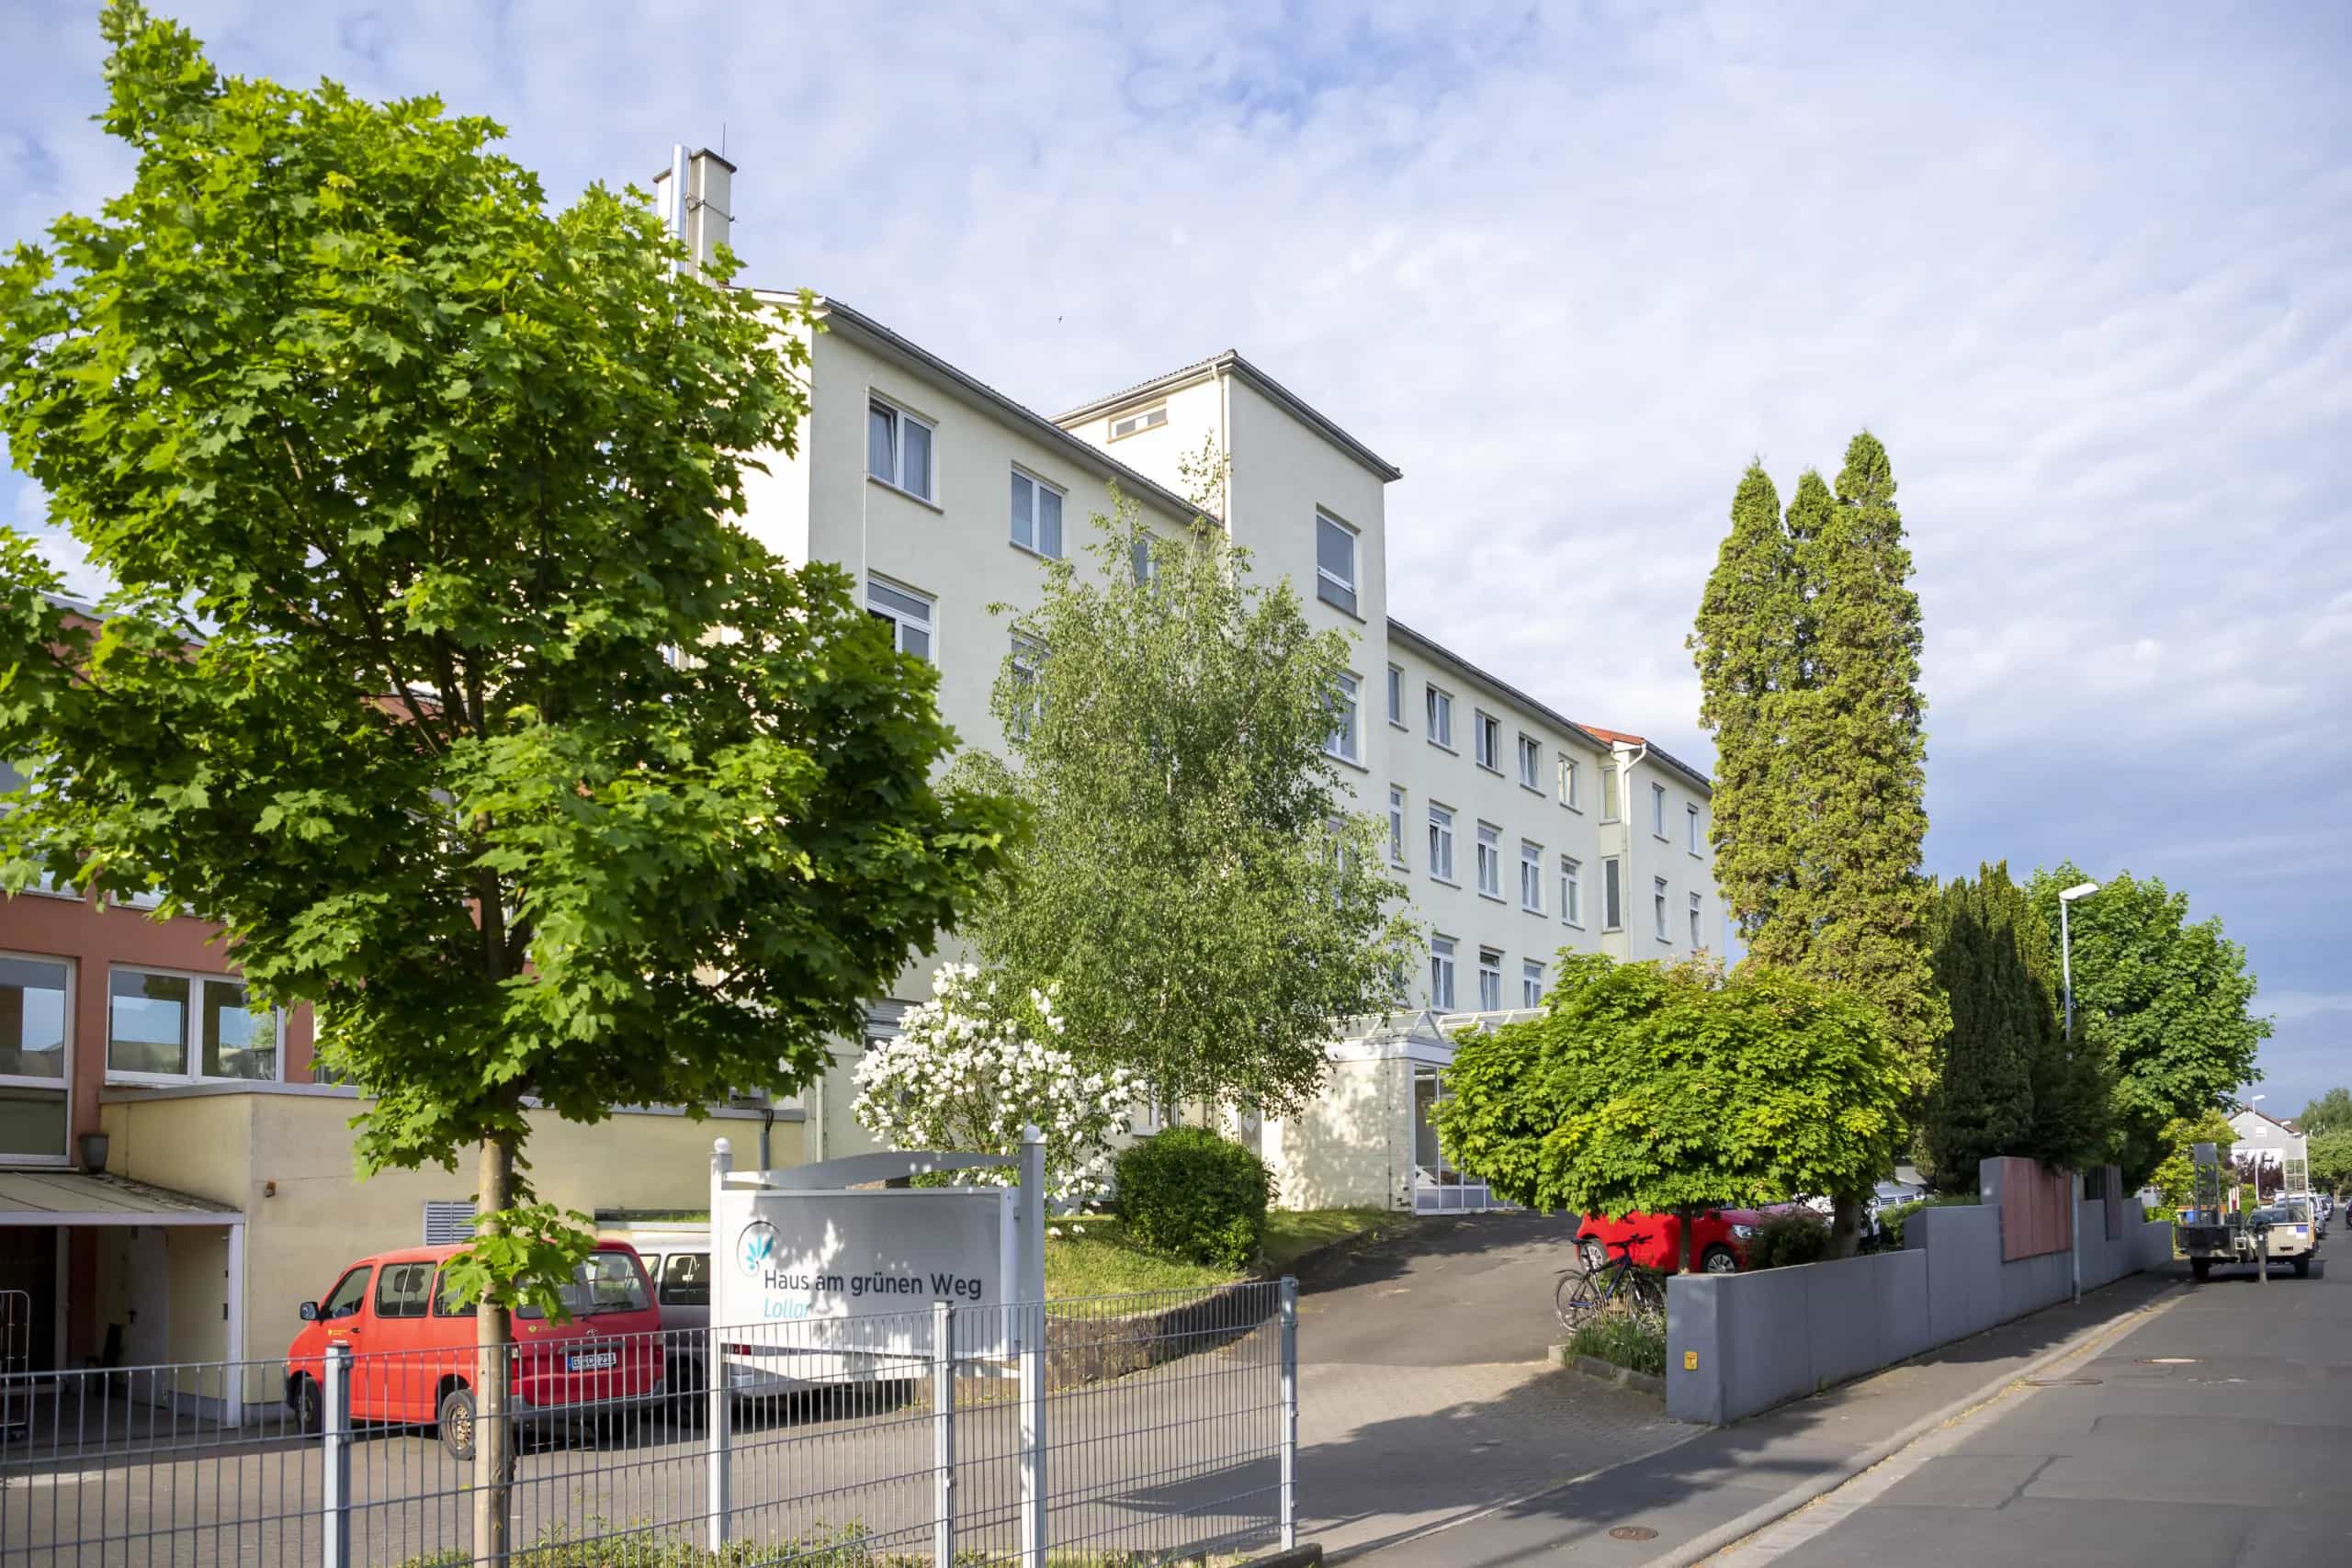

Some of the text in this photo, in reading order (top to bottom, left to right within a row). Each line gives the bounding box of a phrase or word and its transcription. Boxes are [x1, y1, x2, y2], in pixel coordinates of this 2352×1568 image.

[764, 1269, 982, 1300] Haus am grünen Weg
[763, 1297, 811, 1318] Lollar
